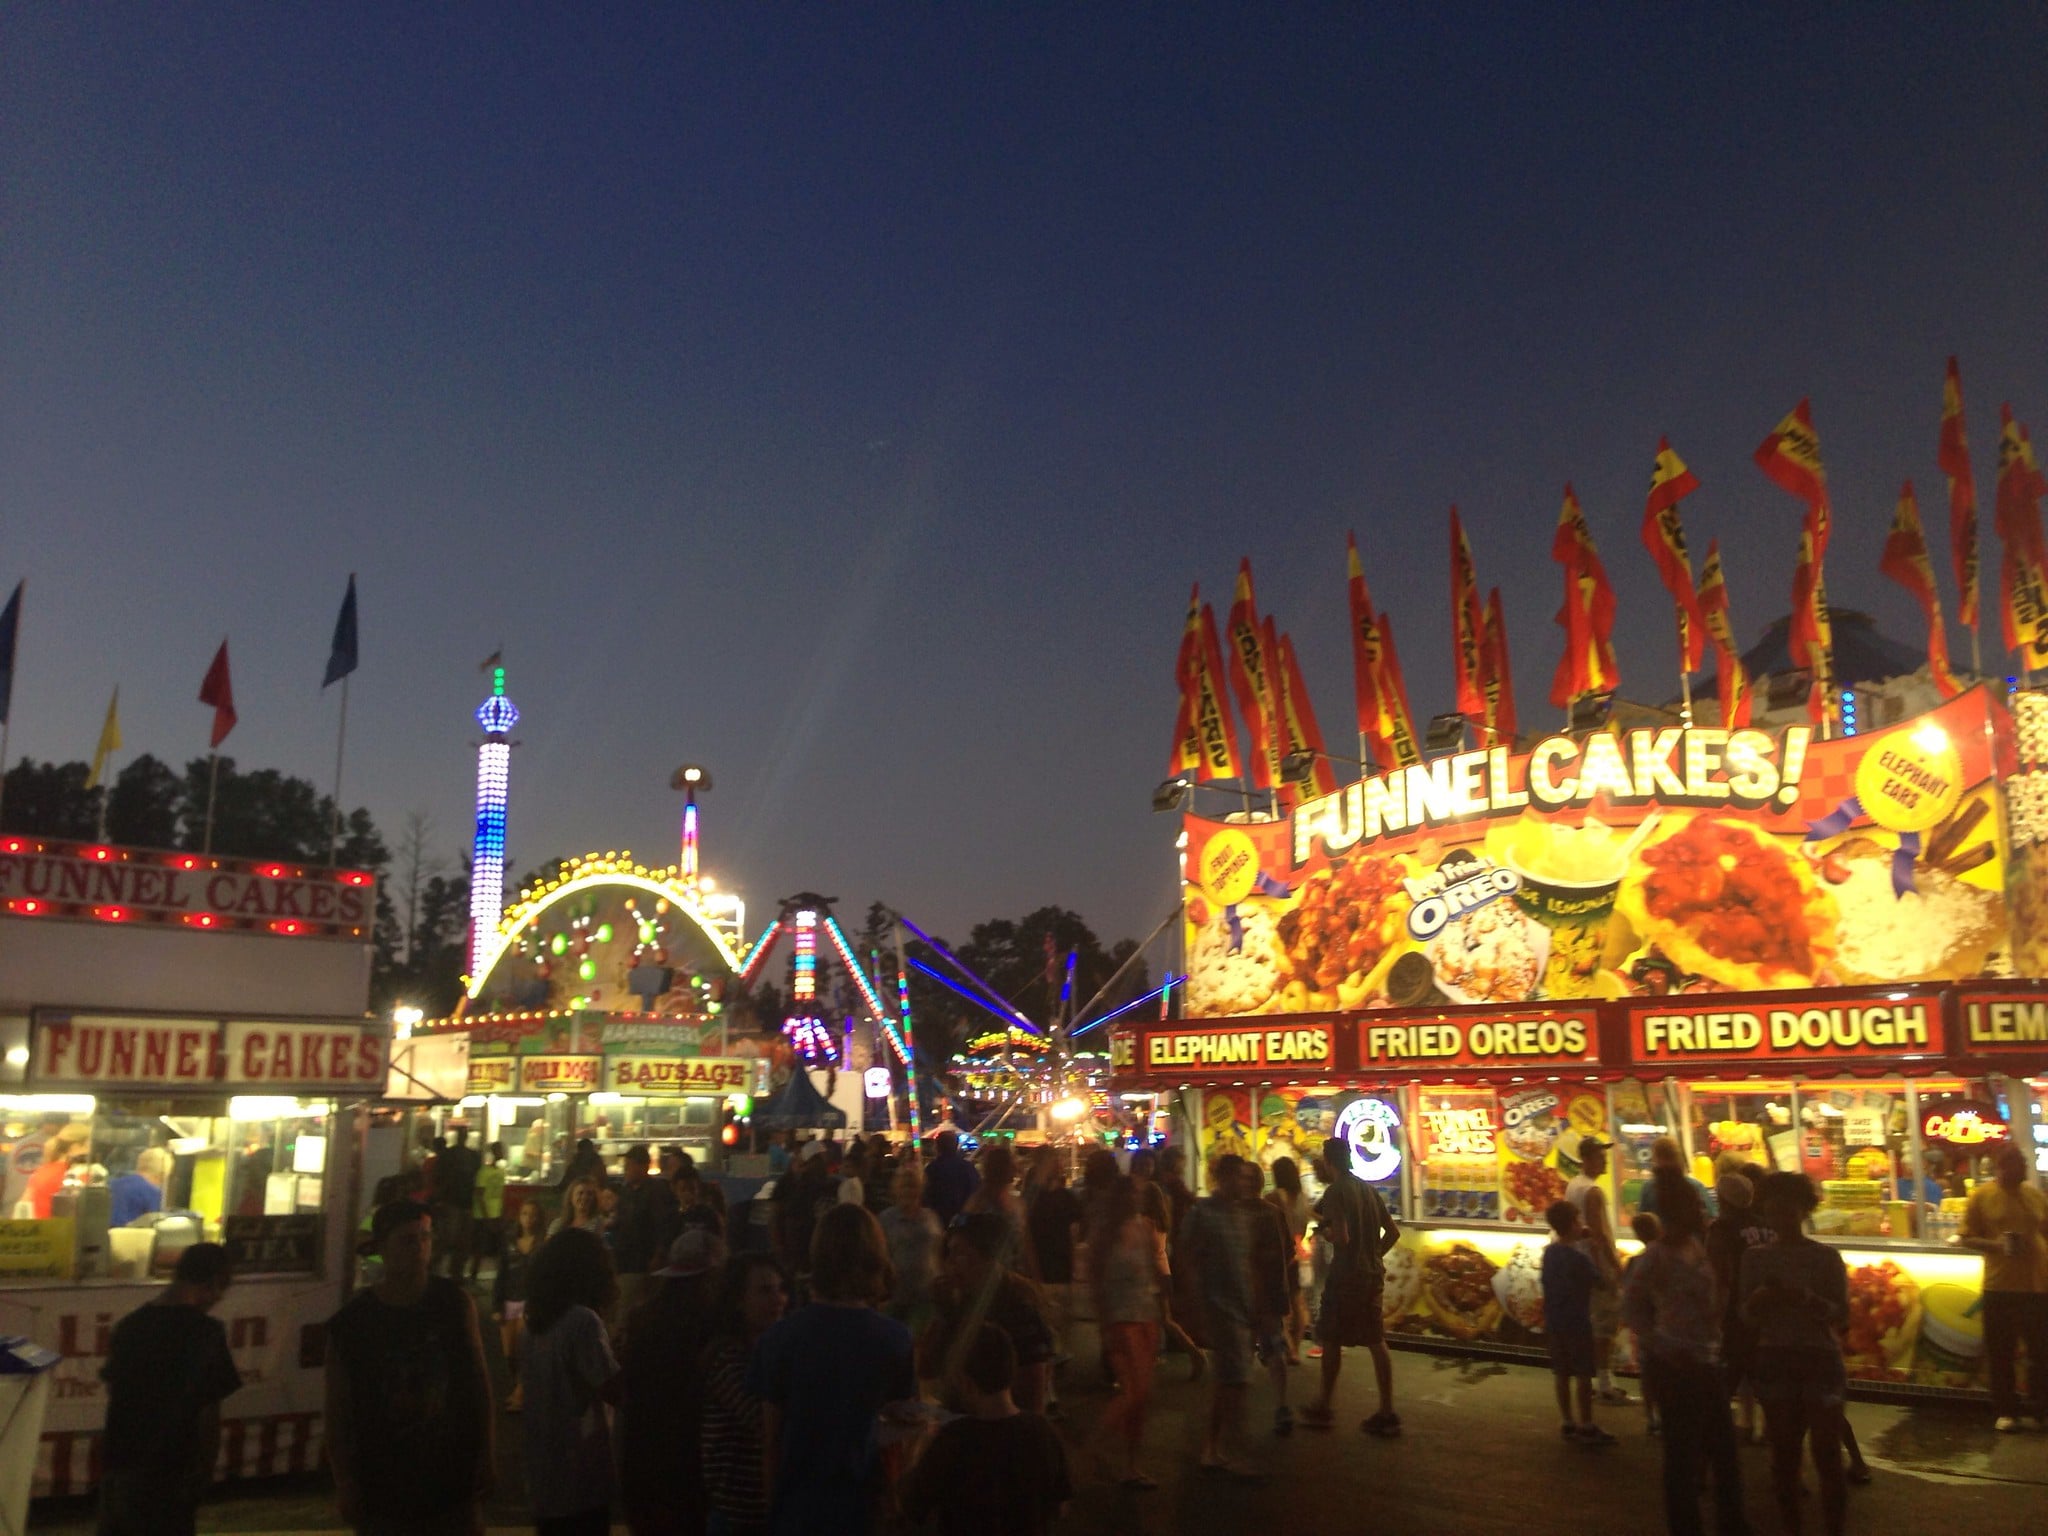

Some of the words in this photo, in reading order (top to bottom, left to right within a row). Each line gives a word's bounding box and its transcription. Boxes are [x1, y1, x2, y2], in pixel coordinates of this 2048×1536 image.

[1294, 745, 1530, 865] FUNNEL
[1530, 727, 1811, 807] CAKES!
[1879, 750, 1950, 799] ELEPHANT
[1881, 778, 1920, 809] EARS
[0, 855, 190, 909] FUNNEL
[206, 874, 364, 922] CAKES
[1211, 849, 1250, 893] TOPPINGS
[1408, 868, 1519, 940] OREO
[1150, 1032, 1262, 1065] ELEPHANT
[1265, 1030, 1329, 1061] EARS
[1369, 1026, 1463, 1058] FRIED
[1467, 1018, 1587, 1055] OREOS
[1644, 1012, 1763, 1052] FRIED
[1770, 1004, 1928, 1048] DOUGH
[49, 1023, 225, 1080] FUNNEL
[242, 1031, 381, 1081] CAKES
[616, 1061, 745, 1087] SAUSAGE
[1503, 1095, 1559, 1128] OREO
